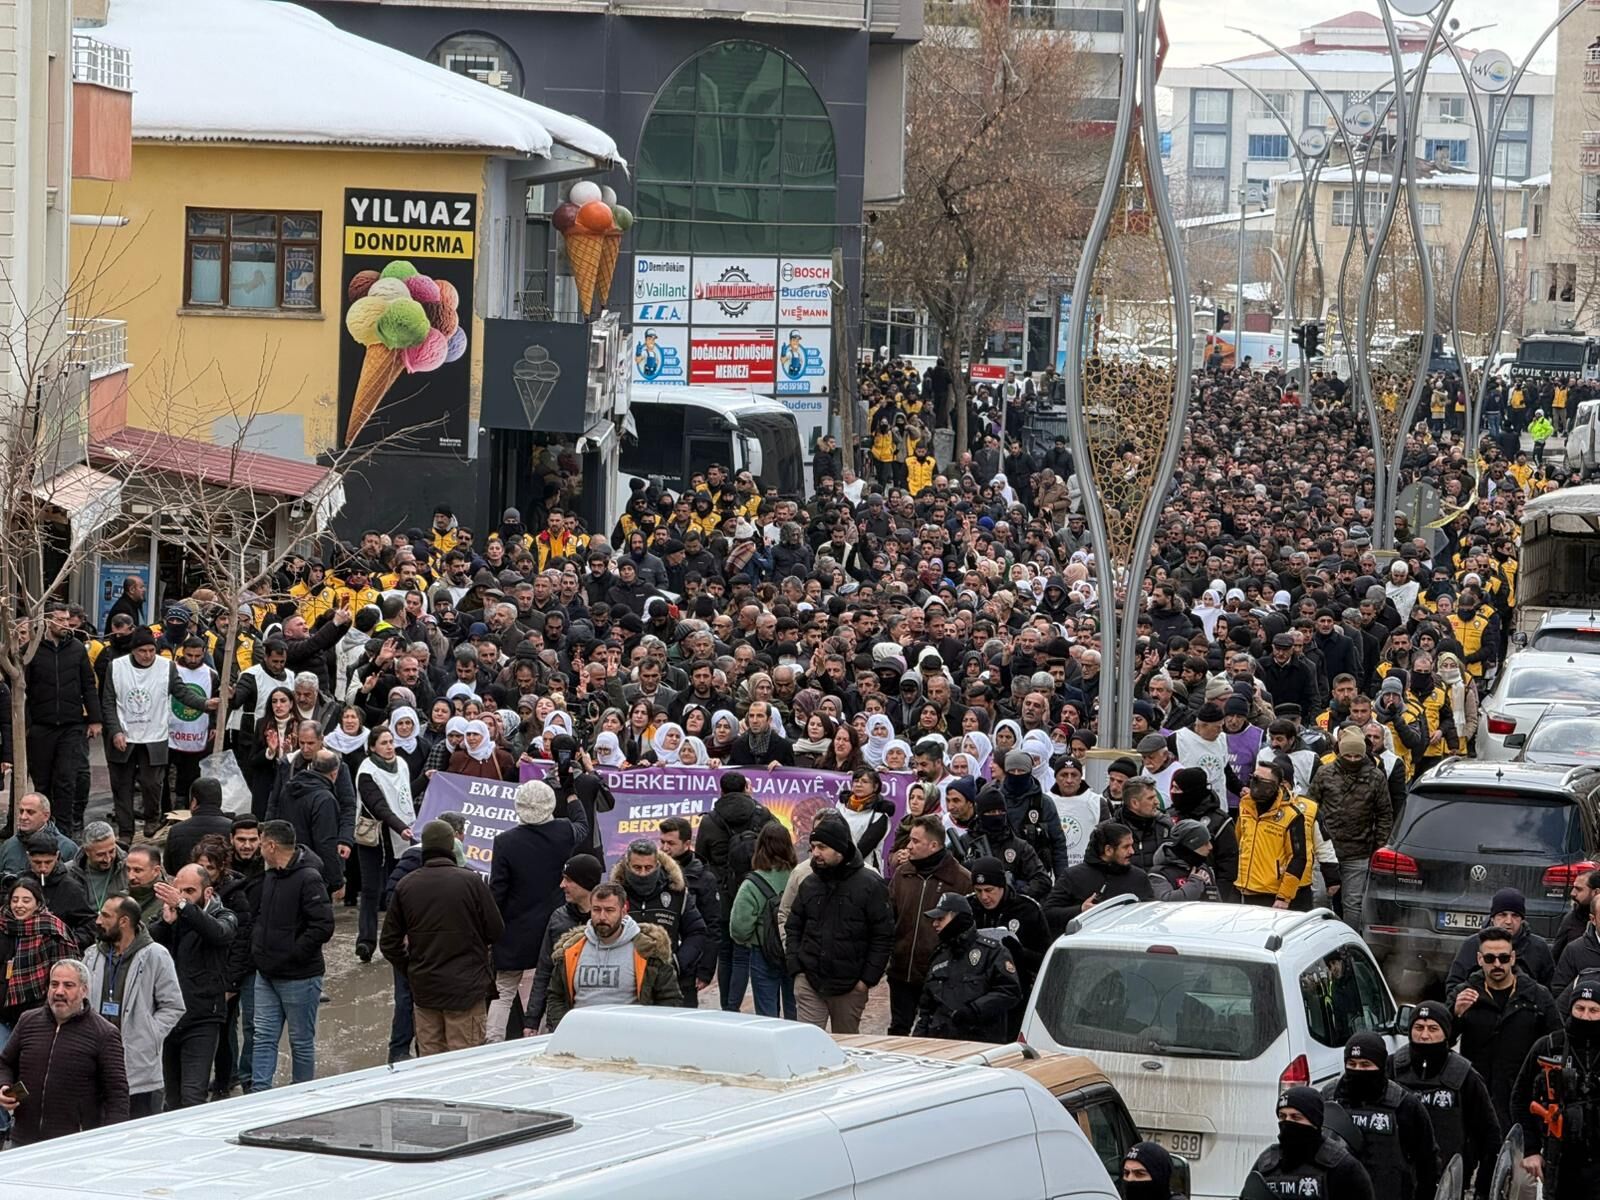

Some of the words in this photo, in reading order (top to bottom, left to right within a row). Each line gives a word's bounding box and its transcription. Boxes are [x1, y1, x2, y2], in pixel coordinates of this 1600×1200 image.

[350, 197, 472, 226] YILMAZ
[354, 232, 465, 254] DONDURMA
[794, 267, 830, 279] BOSCH
[646, 282, 687, 298] Vaillant
[781, 286, 828, 298] Buderus
[691, 343, 733, 360] DOĞALGAZ
[733, 343, 774, 363] DÖNÜŞÜM
[783, 400, 822, 410] Buderus
[468, 781, 499, 798] EM
[608, 773, 718, 791] DERKETINA
[461, 802, 521, 823] DAGIR
[629, 798, 704, 819] KEZIYÊN
[1445, 913, 1458, 926] 34
[580, 966, 618, 987] LOFT
[1171, 1134, 1199, 1152] 968
